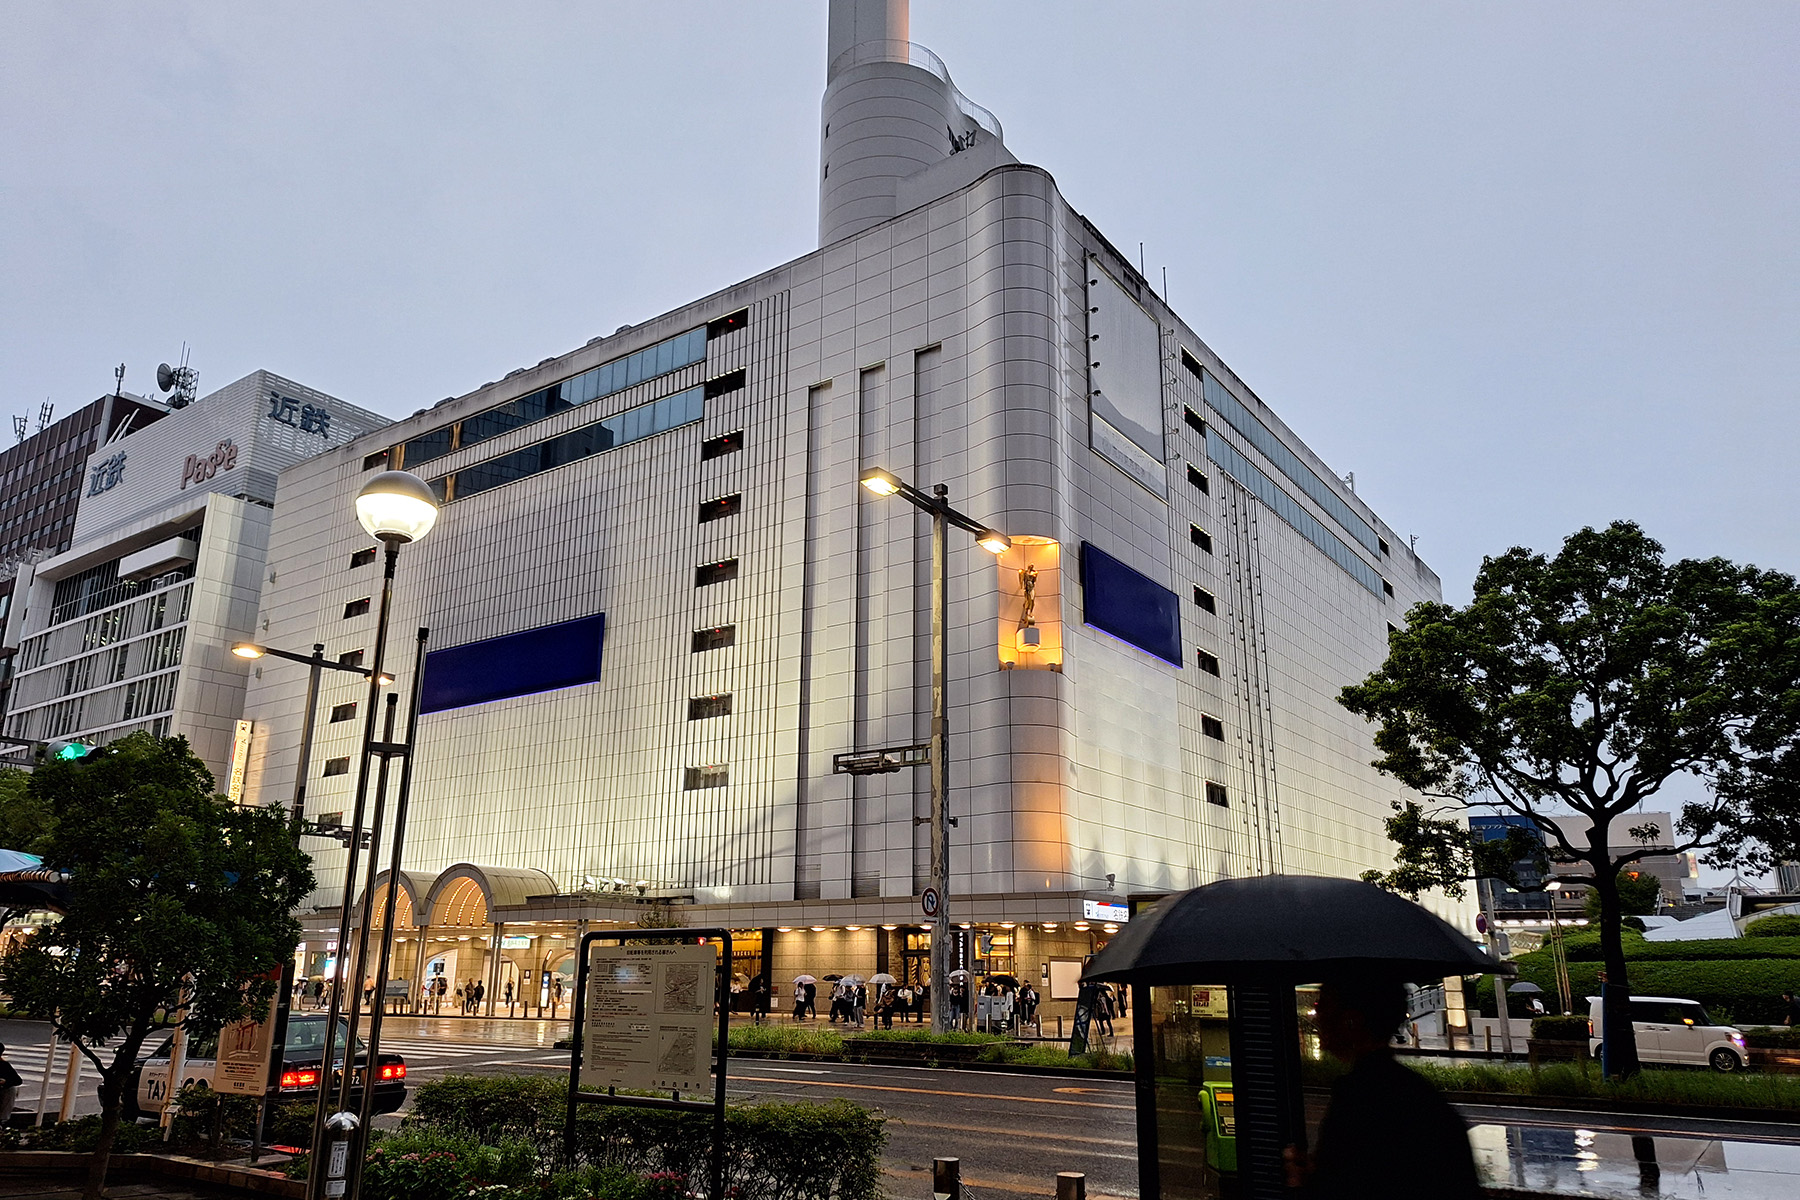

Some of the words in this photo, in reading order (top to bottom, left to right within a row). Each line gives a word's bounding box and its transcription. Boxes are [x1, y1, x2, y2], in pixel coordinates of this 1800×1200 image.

[267, 390, 331, 439] 近鉄
[86, 450, 127, 498] 近鉄
[147, 1079, 167, 1101] TAX
